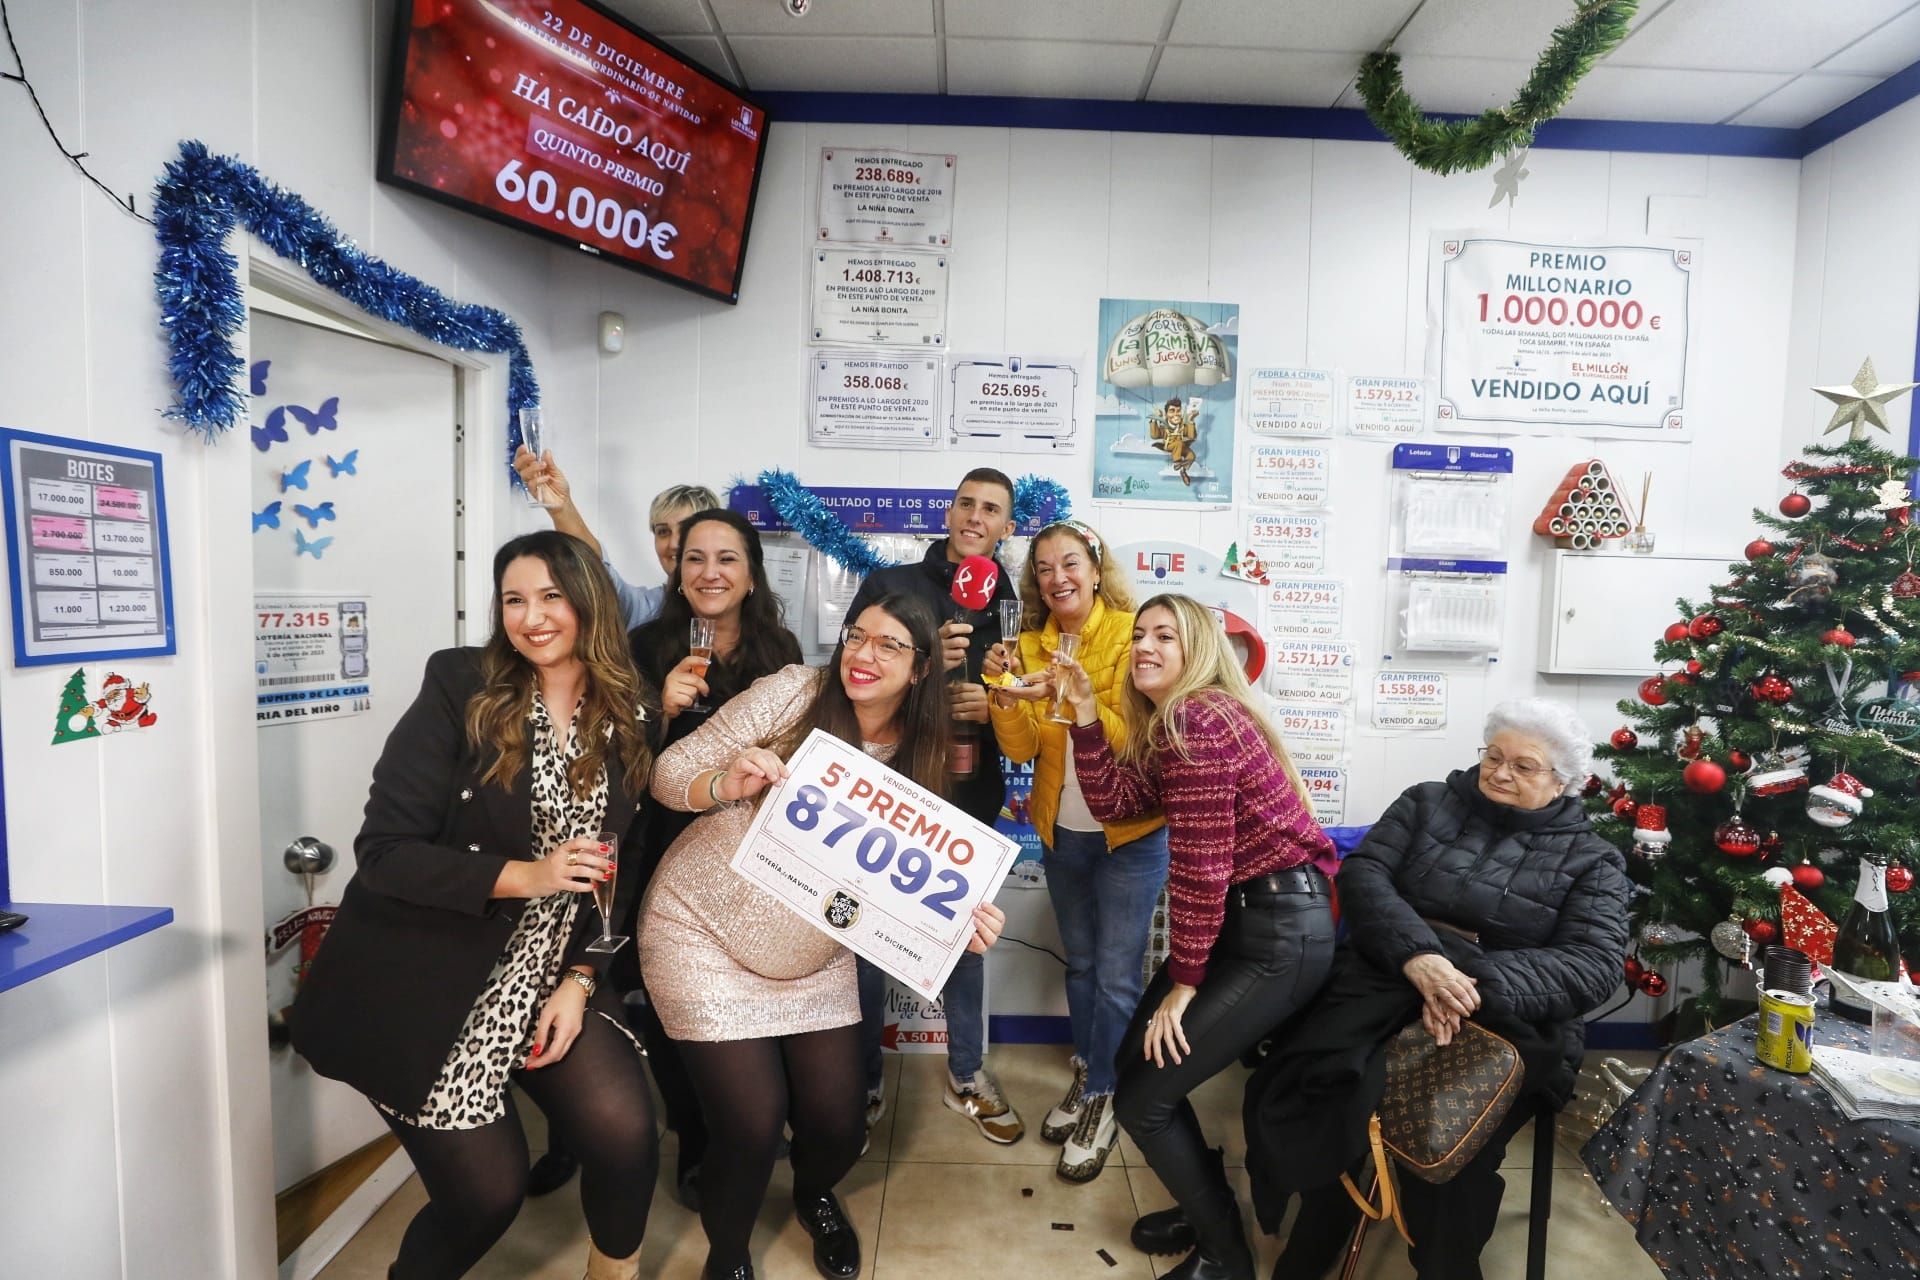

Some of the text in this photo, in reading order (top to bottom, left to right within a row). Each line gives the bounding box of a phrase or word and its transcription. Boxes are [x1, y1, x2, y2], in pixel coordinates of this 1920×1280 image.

[542, 11, 685, 100] 22 DE DICIEMBRE
[513, 17, 701, 124] SORTEO EXTRAORDINARIO DE NAVIDAD
[512, 73, 692, 176] HA CAÍDO AQUÍ
[534, 129, 665, 196] QUINTO PREMIO
[854, 157, 923, 168] HEMOS ENTREGADO
[855, 167, 914, 184] 238.689
[843, 184, 874, 192] PREMIOS
[892, 187, 915, 195] LARGO
[495, 159, 678, 260] 60.000€
[868, 203, 886, 212] NIÑA
[888, 205, 915, 214] BONITA
[874, 260, 916, 268] ENTREGADO
[1530, 252, 1607, 271] PREMIO
[842, 269, 913, 284] 1.408.713
[1506, 273, 1632, 296] MILLONARIO
[851, 305, 908, 314] LA NIÑA BONITA
[1477, 293, 1643, 330] 1.000.000
[1568, 332, 1613, 340] MILLONARIOS
[1624, 334, 1650, 342] ESPAÑA
[870, 362, 909, 370] REPARTIDO
[1572, 362, 1628, 374] EL MILLÓN
[843, 375, 901, 390] 358.068
[982, 383, 1040, 397] 625.695
[1356, 389, 1413, 402] 1.579,12
[1471, 378, 1651, 406] VENDIDO AQUÍ
[841, 403, 857, 411] ESTE
[67, 459, 115, 482] BOTES
[1256, 458, 1315, 470] 1.504,43
[38, 493, 84, 504] 17.000.000
[820, 497, 953, 509] SULTADO DE LOS SOR
[1256, 516, 1280, 524] GRAN
[102, 534, 144, 543] 13.700.000
[1254, 526, 1311, 539] 3.534,33
[49, 568, 138, 577] 850.000 10.000
[1273, 591, 1330, 604] 6.427,94
[54, 605, 147, 614] 11.000 1.230.000
[258, 612, 329, 628] 77.315
[1312, 644, 1346, 652] PREMIO
[1278, 652, 1339, 667] 2.571,17
[1407, 674, 1440, 682] PREMIO
[326, 689, 340, 697] LA
[343, 686, 369, 695] CASA
[1279, 689, 1316, 698] VENDIDO
[1379, 684, 1435, 696] 1.558,49
[256, 703, 340, 720] RIA DEL NIÑO
[1306, 710, 1339, 718] PREMIO
[1284, 717, 1328, 731] 967,13
[1301, 769, 1338, 778] PREMIO
[882, 773, 942, 813] VENDIDO AQUÍ
[847, 777, 975, 866] PREMIO
[785, 784, 970, 922] 87092
[756, 852, 782, 873] LOTERÍA
[788, 873, 818, 897] NAVIDAD
[874, 930, 923, 962] 22 DICIEMBRE
[896, 1032, 949, 1042] A 50 M
